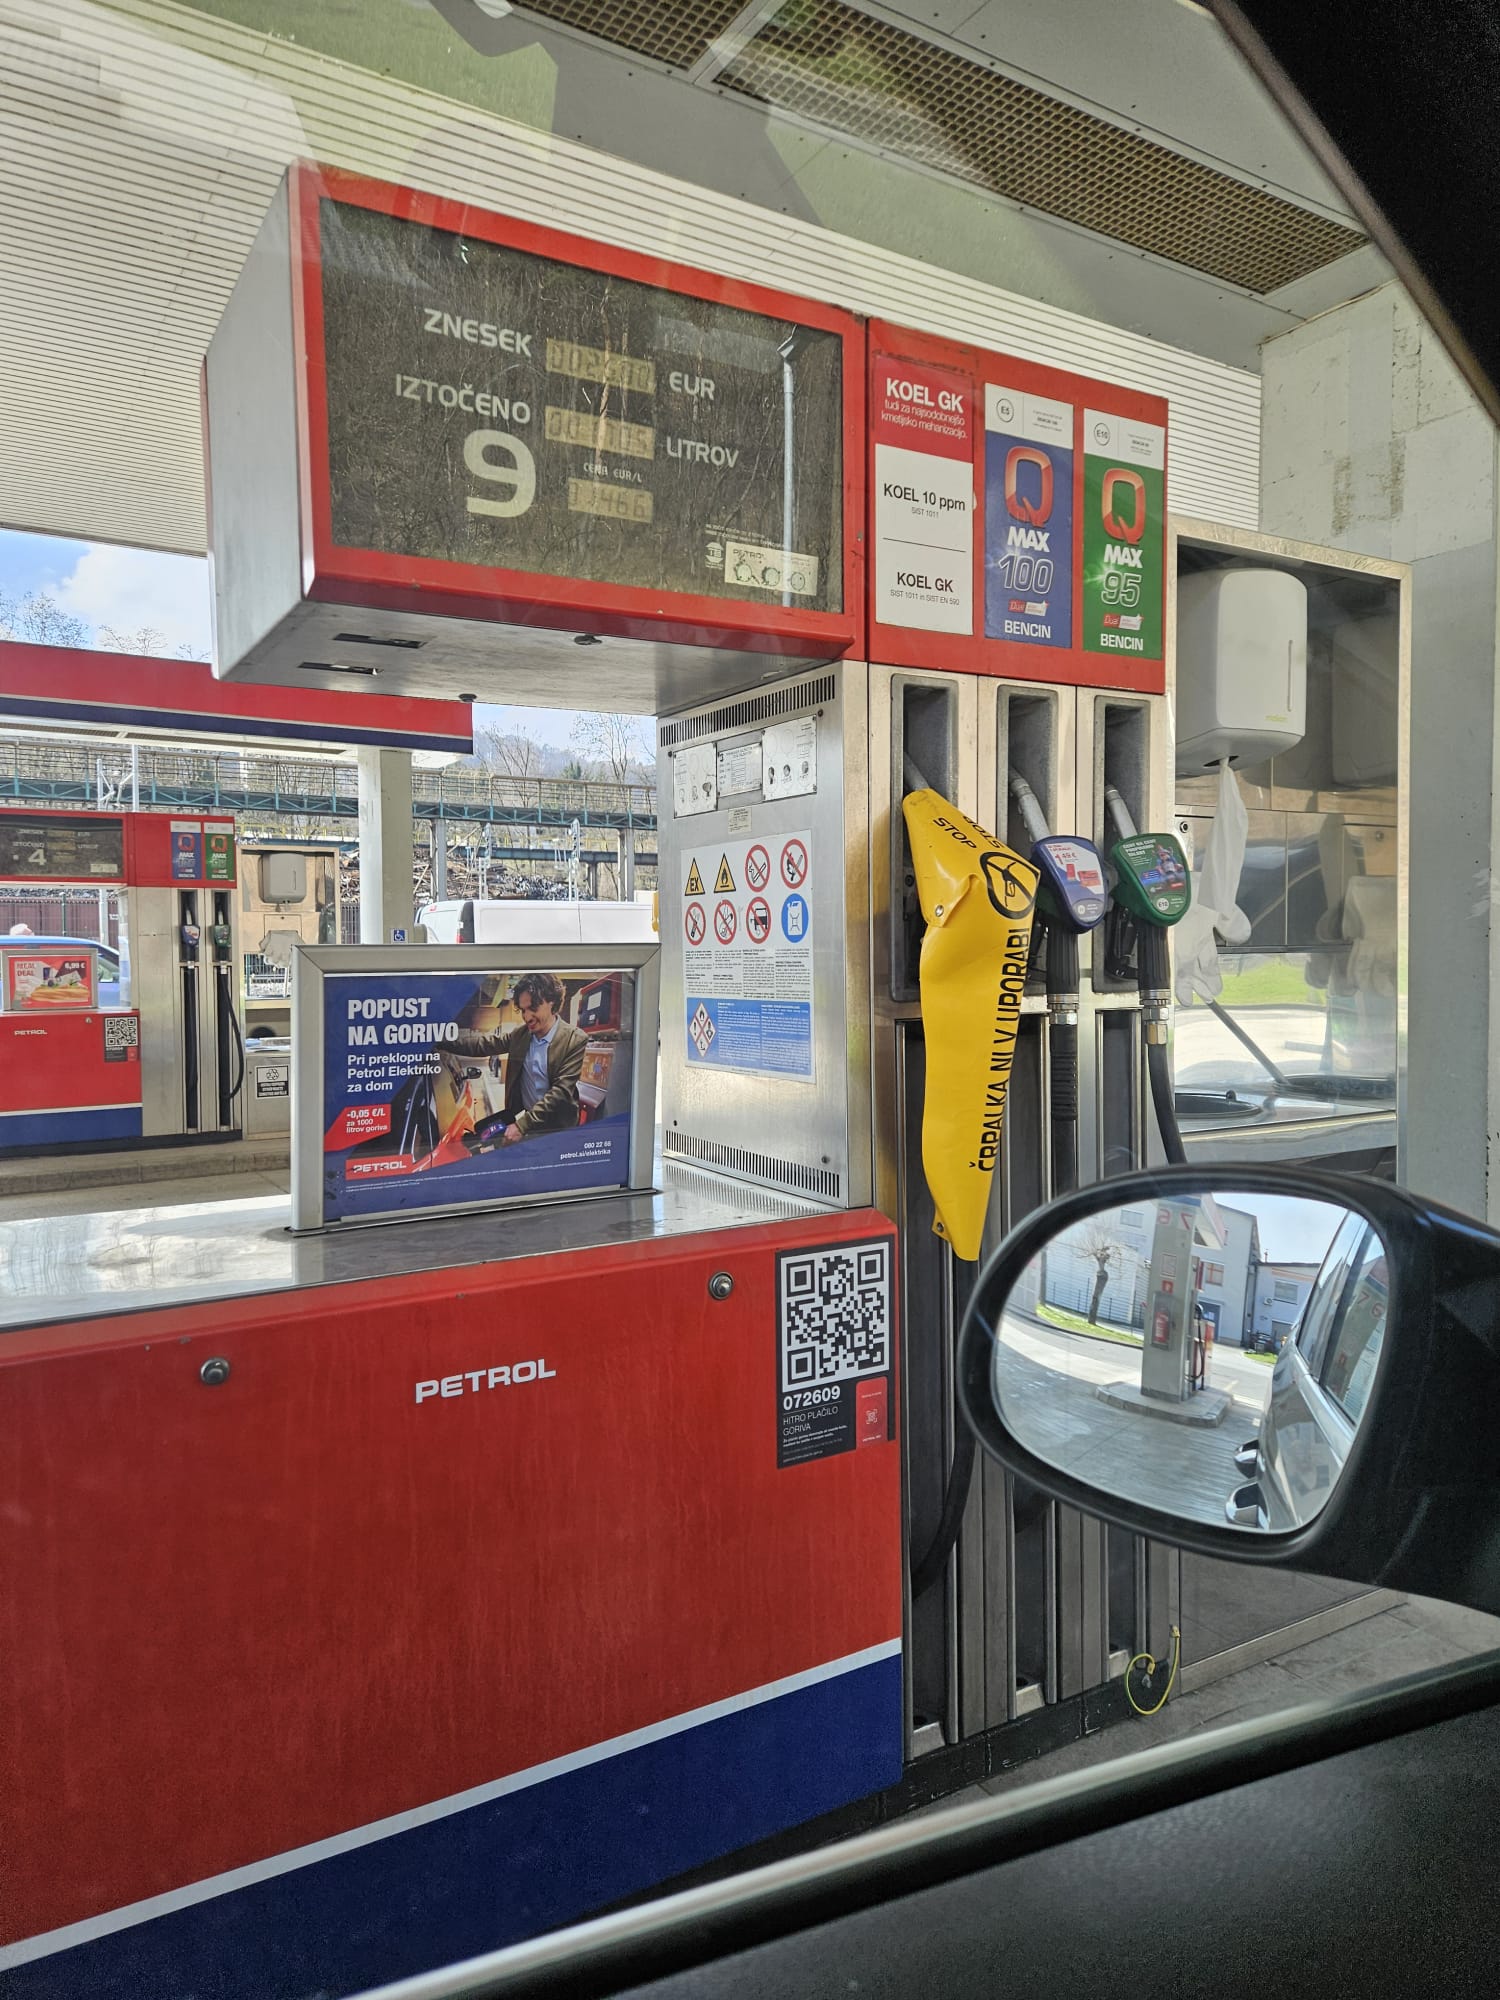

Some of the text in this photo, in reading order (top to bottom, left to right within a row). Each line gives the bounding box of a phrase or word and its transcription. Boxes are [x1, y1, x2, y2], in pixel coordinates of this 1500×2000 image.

[424, 308, 532, 357] ZNESEK
[669, 371, 715, 400] EUR
[886, 377, 964, 414] KOEL GK
[396, 373, 531, 424] IZTOČENO
[901, 403, 911, 413] za
[1001, 406, 1010, 415] E5
[666, 436, 739, 468] LITROV
[463, 428, 536, 518] 9
[583, 462, 642, 483] CENA EUR/L
[884, 483, 966, 511] KOEL 10 ppm
[1005, 445, 1054, 528] Q
[912, 507, 939, 518] SIST 1011
[1101, 467, 1146, 545] Q
[1007, 526, 1051, 552] MAX
[1103, 544, 1143, 568] MAX
[897, 571, 954, 593] KOEL GK
[998, 553, 1054, 594] 100
[890, 589, 904, 598] SIST
[905, 591, 918, 600] 1011
[926, 595, 939, 603] SIST
[1101, 570, 1142, 608] 95
[1004, 619, 1051, 639] BENCIN
[1100, 633, 1144, 651] BENCIN
[933, 817, 977, 849] STOP
[28, 848, 47, 866] 4
[690, 877, 699, 892] EX
[348, 997, 431, 1019] POPUST
[348, 1022, 459, 1046] NA GORIVO
[347, 1052, 440, 1067] Pri preklopu na
[968, 928, 1030, 1172] ČRPALKA NI V UPORABI
[347, 1064, 442, 1079] Petrol Elektriko
[347, 1080, 393, 1093] za dom
[346, 1107, 386, 1120] -0,05 €/L
[365, 1124, 388, 1133] goriva
[353, 1160, 407, 1174] PETROL
[415, 1358, 556, 1404] PETROL
[783, 1385, 840, 1411] 072609
[783, 1405, 839, 1425] HITRO PLAČILO
[783, 1423, 811, 1436] GORIVA
